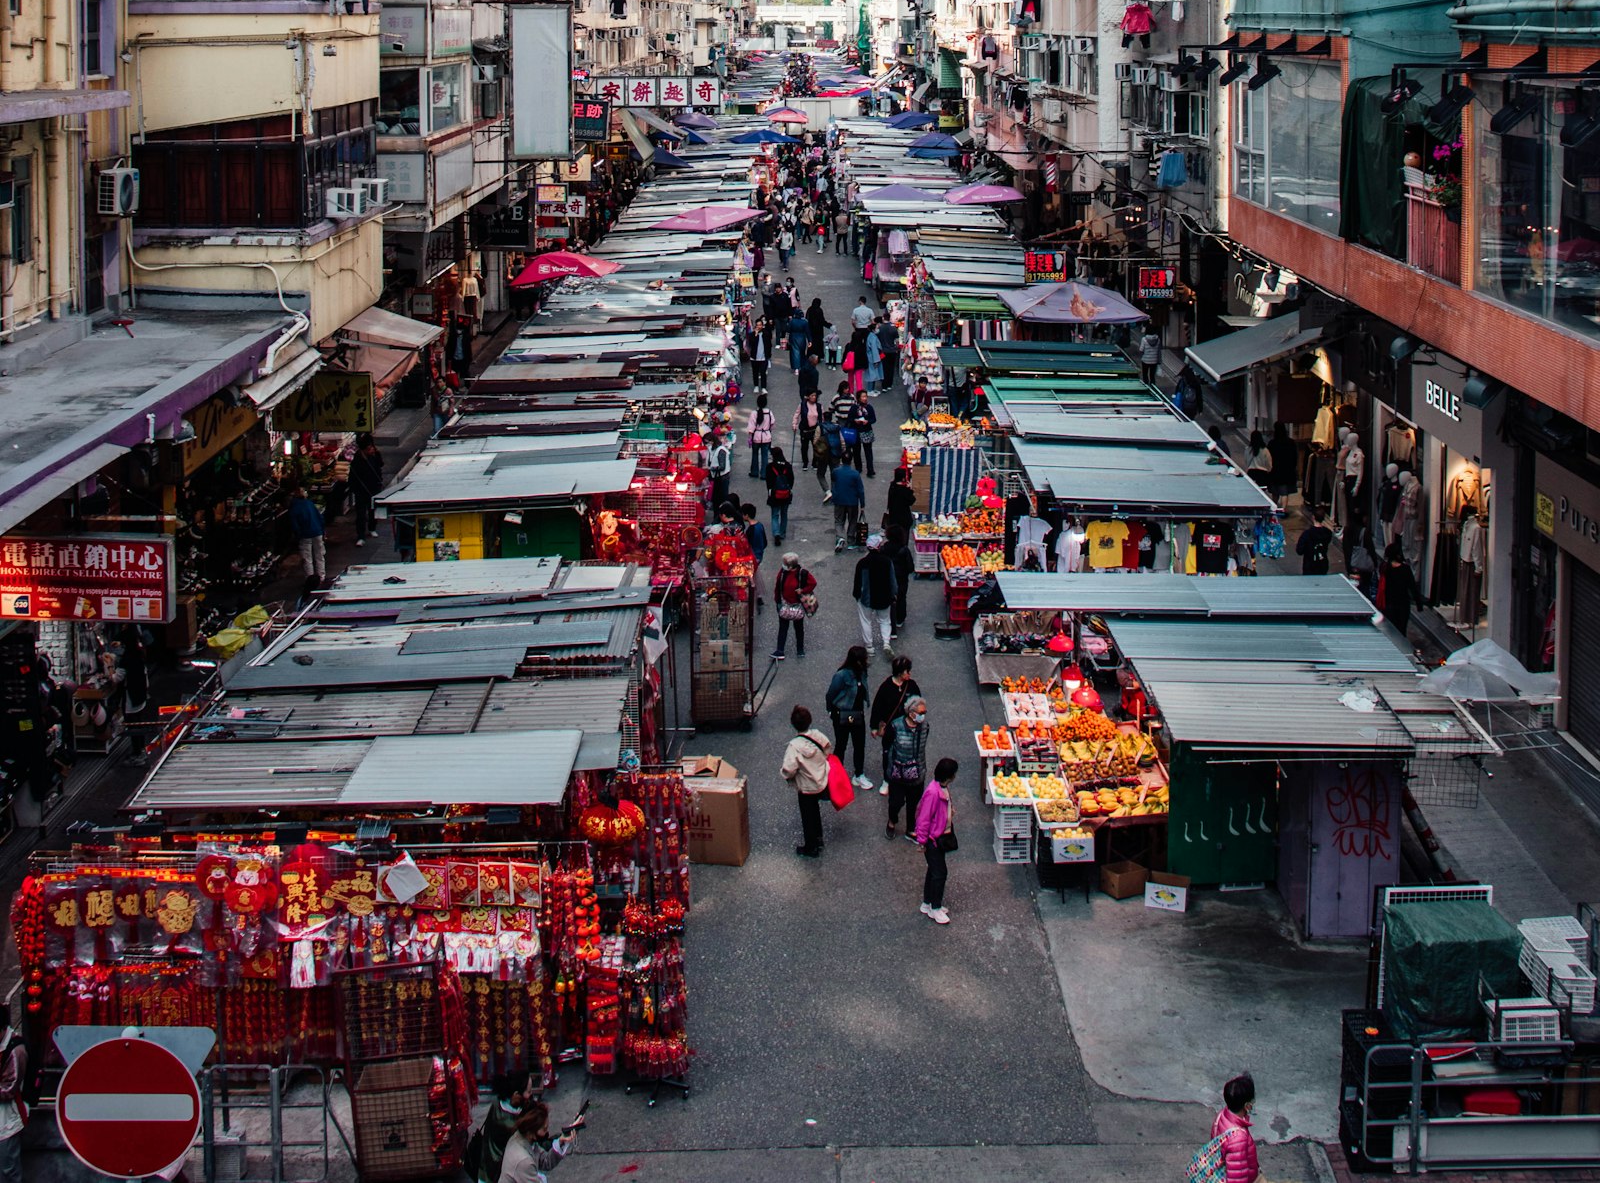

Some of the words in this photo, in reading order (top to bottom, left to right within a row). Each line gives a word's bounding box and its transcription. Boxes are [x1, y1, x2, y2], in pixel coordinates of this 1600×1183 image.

[1028, 273, 1064, 281] 91755993
[1140, 289, 1174, 297] 91755993
[1426, 380, 1460, 422] BELLE
[0, 542, 163, 570] 電話直銷中心
[32, 568, 72, 577] DIRECT
[73, 569, 118, 578] SELLING
[120, 570, 163, 579] CENTRE
[37, 586, 49, 594] Ang
[142, 588, 162, 597] Filipino
